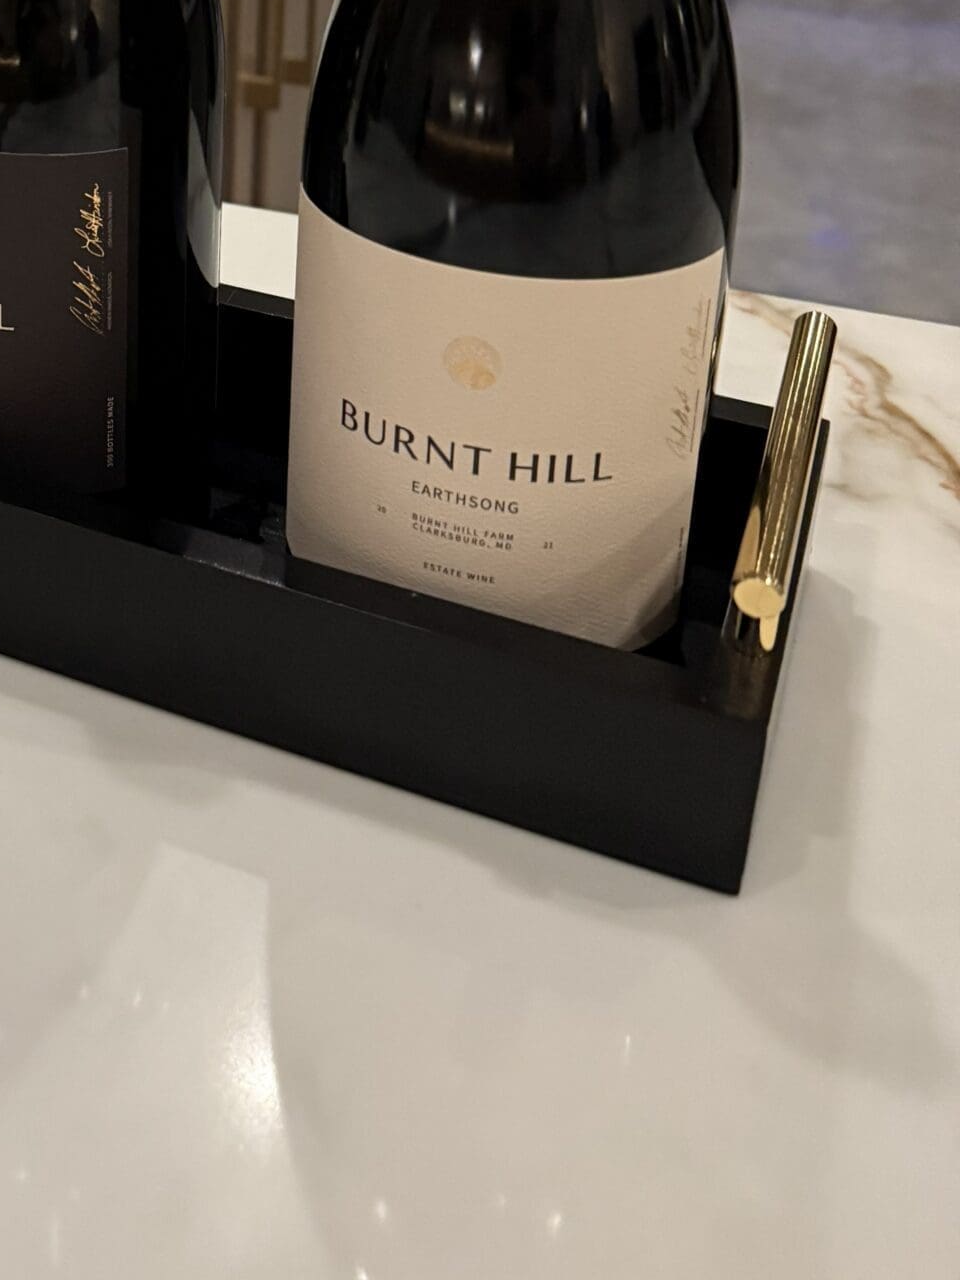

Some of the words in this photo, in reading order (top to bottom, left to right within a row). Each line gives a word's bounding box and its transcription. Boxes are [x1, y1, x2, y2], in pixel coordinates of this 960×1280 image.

[106, 396, 114, 418] MADE
[106, 418, 114, 453] BOTTLES
[340, 397, 492, 477] BURNT
[508, 451, 613, 485] HILL
[412, 479, 519, 514] EARTHSONG
[411, 512, 448, 530] BURNT
[452, 524, 480, 538] HILL
[483, 530, 515, 542] FARM
[412, 521, 492, 549] CLARKSBURG,
[495, 541, 513, 551] MD
[423, 561, 462, 579] ESTATE
[466, 571, 497, 585] WINE
